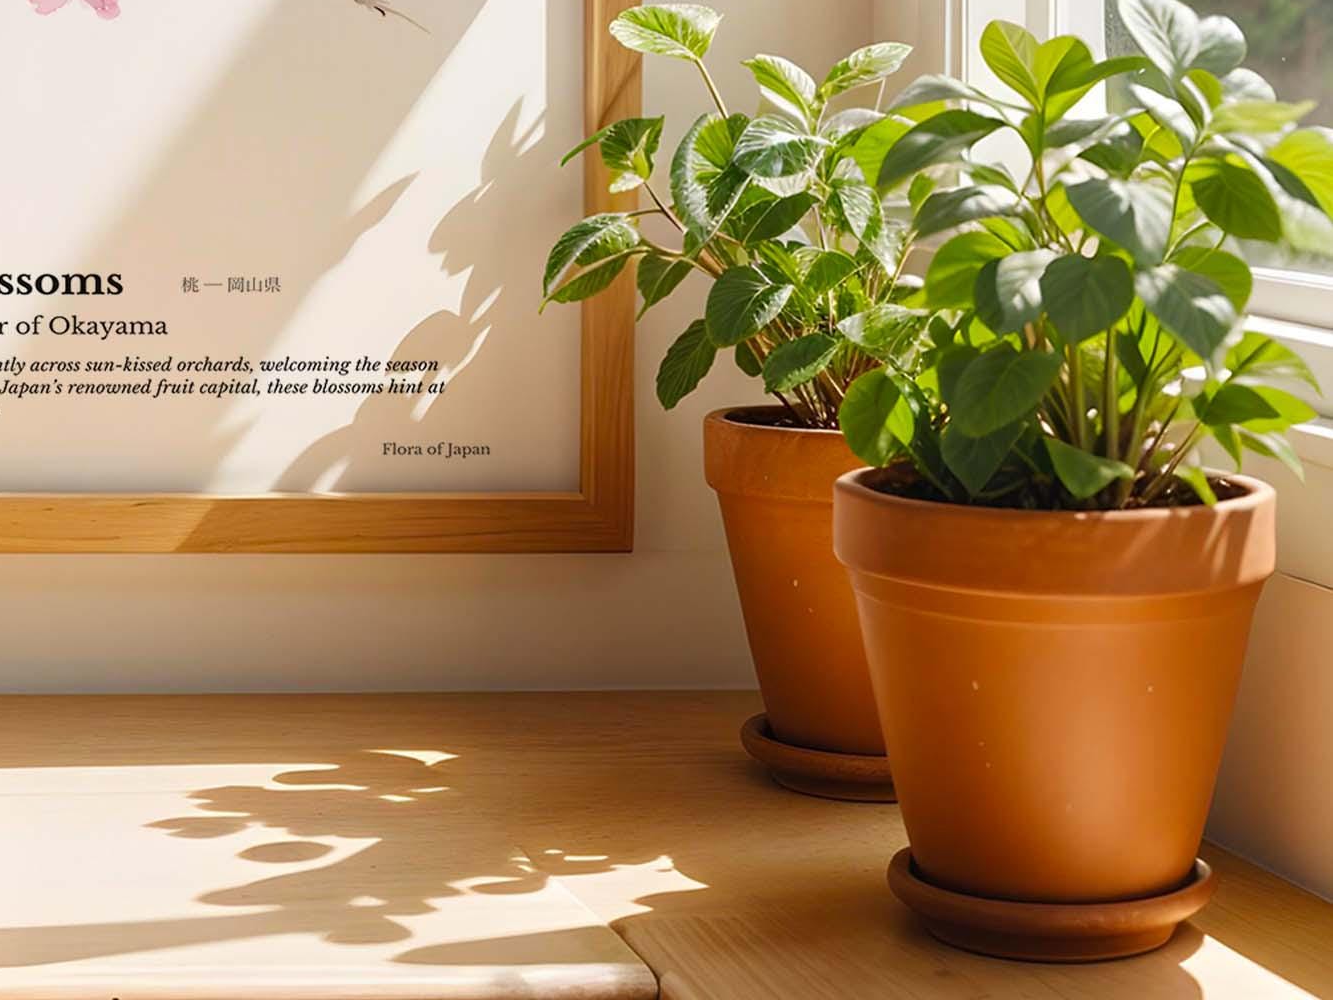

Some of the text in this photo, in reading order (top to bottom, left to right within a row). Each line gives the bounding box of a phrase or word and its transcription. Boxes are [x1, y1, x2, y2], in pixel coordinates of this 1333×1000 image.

[181, 276, 199, 293] 桃
[227, 276, 281, 293] 岡山県
[15, 314, 44, 336] of
[48, 314, 169, 341] Okayama
[29, 360, 81, 373] across
[85, 356, 173, 373] sun-kissed
[176, 356, 254, 375] orchards,
[259, 356, 352, 376] welcoming
[354, 356, 381, 373] the
[384, 360, 439, 373] season
[67, 378, 152, 395] renowned
[152, 378, 195, 399] fruit
[199, 378, 261, 399] capital,
[267, 378, 308, 395] these
[312, 378, 384, 395] blossoms
[387, 378, 423, 395] hint
[428, 381, 446, 395] at
[382, 441, 491, 459] Flora of Japan
